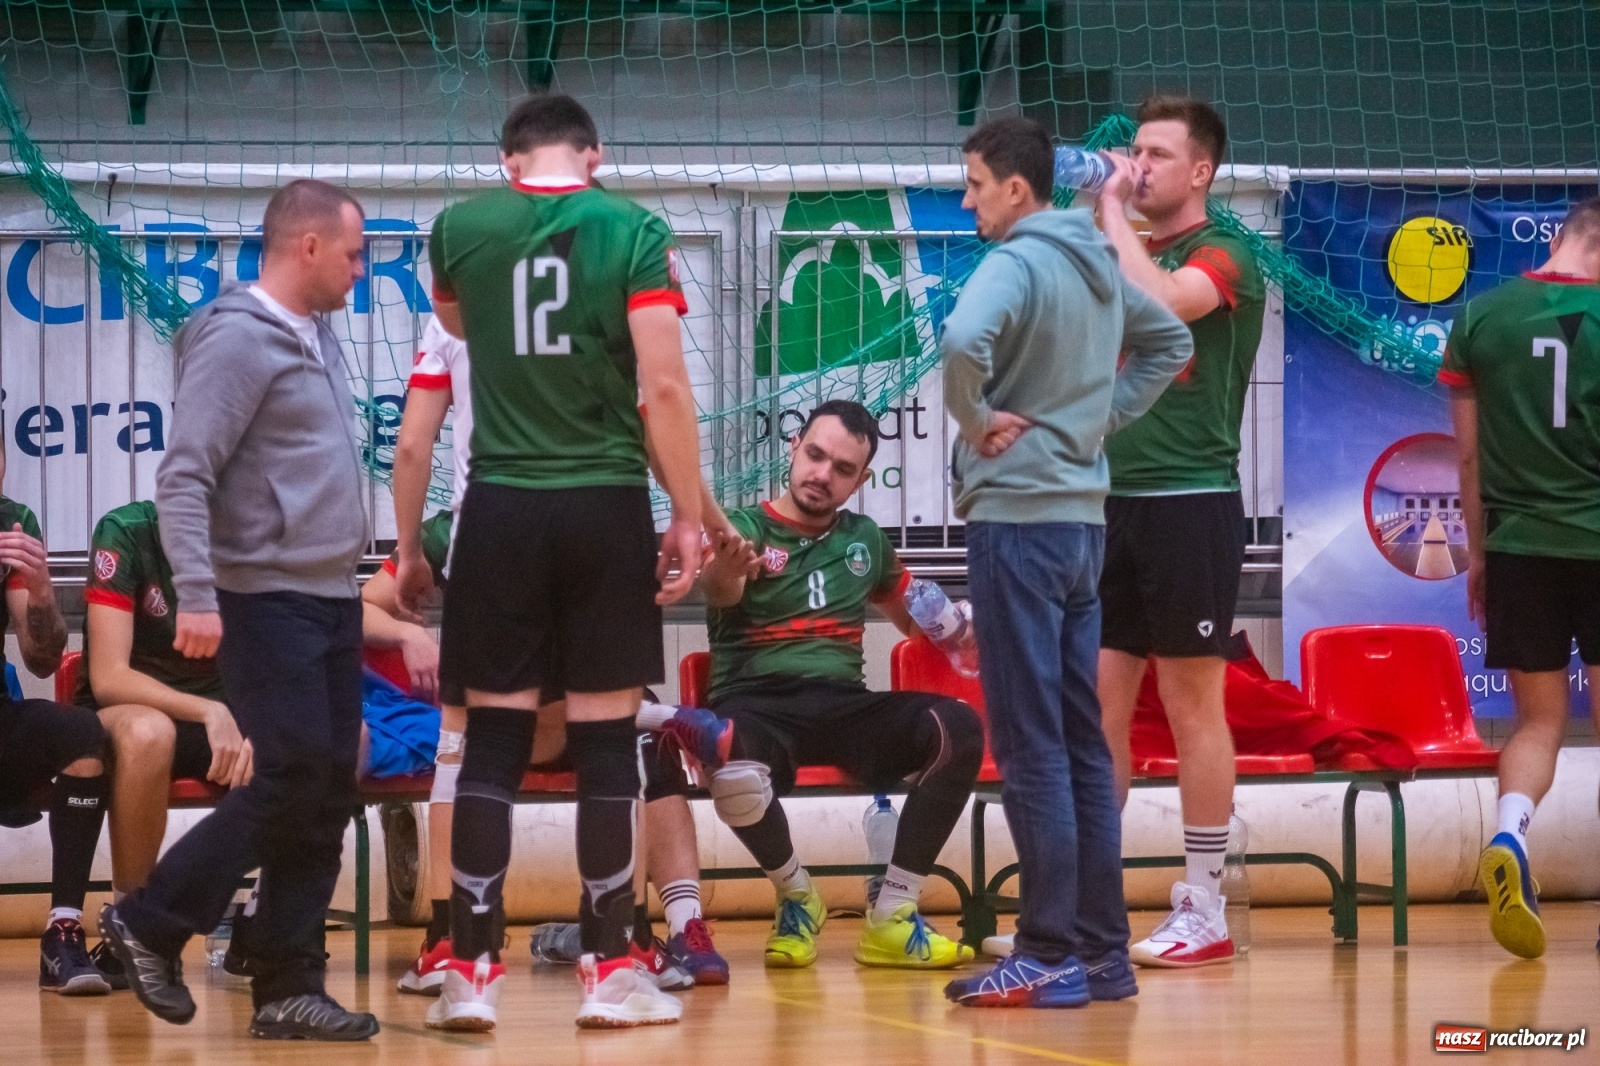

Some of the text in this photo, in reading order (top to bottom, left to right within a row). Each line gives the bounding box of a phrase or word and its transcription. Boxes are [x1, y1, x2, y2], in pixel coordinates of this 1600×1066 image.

[1511, 215, 1563, 243] Ośr
[513, 256, 571, 356] 12
[1532, 337, 1568, 428] 7
[807, 570, 827, 610] 8
[67, 796, 99, 806] SELECT
[1036, 965, 1079, 988] salomon
